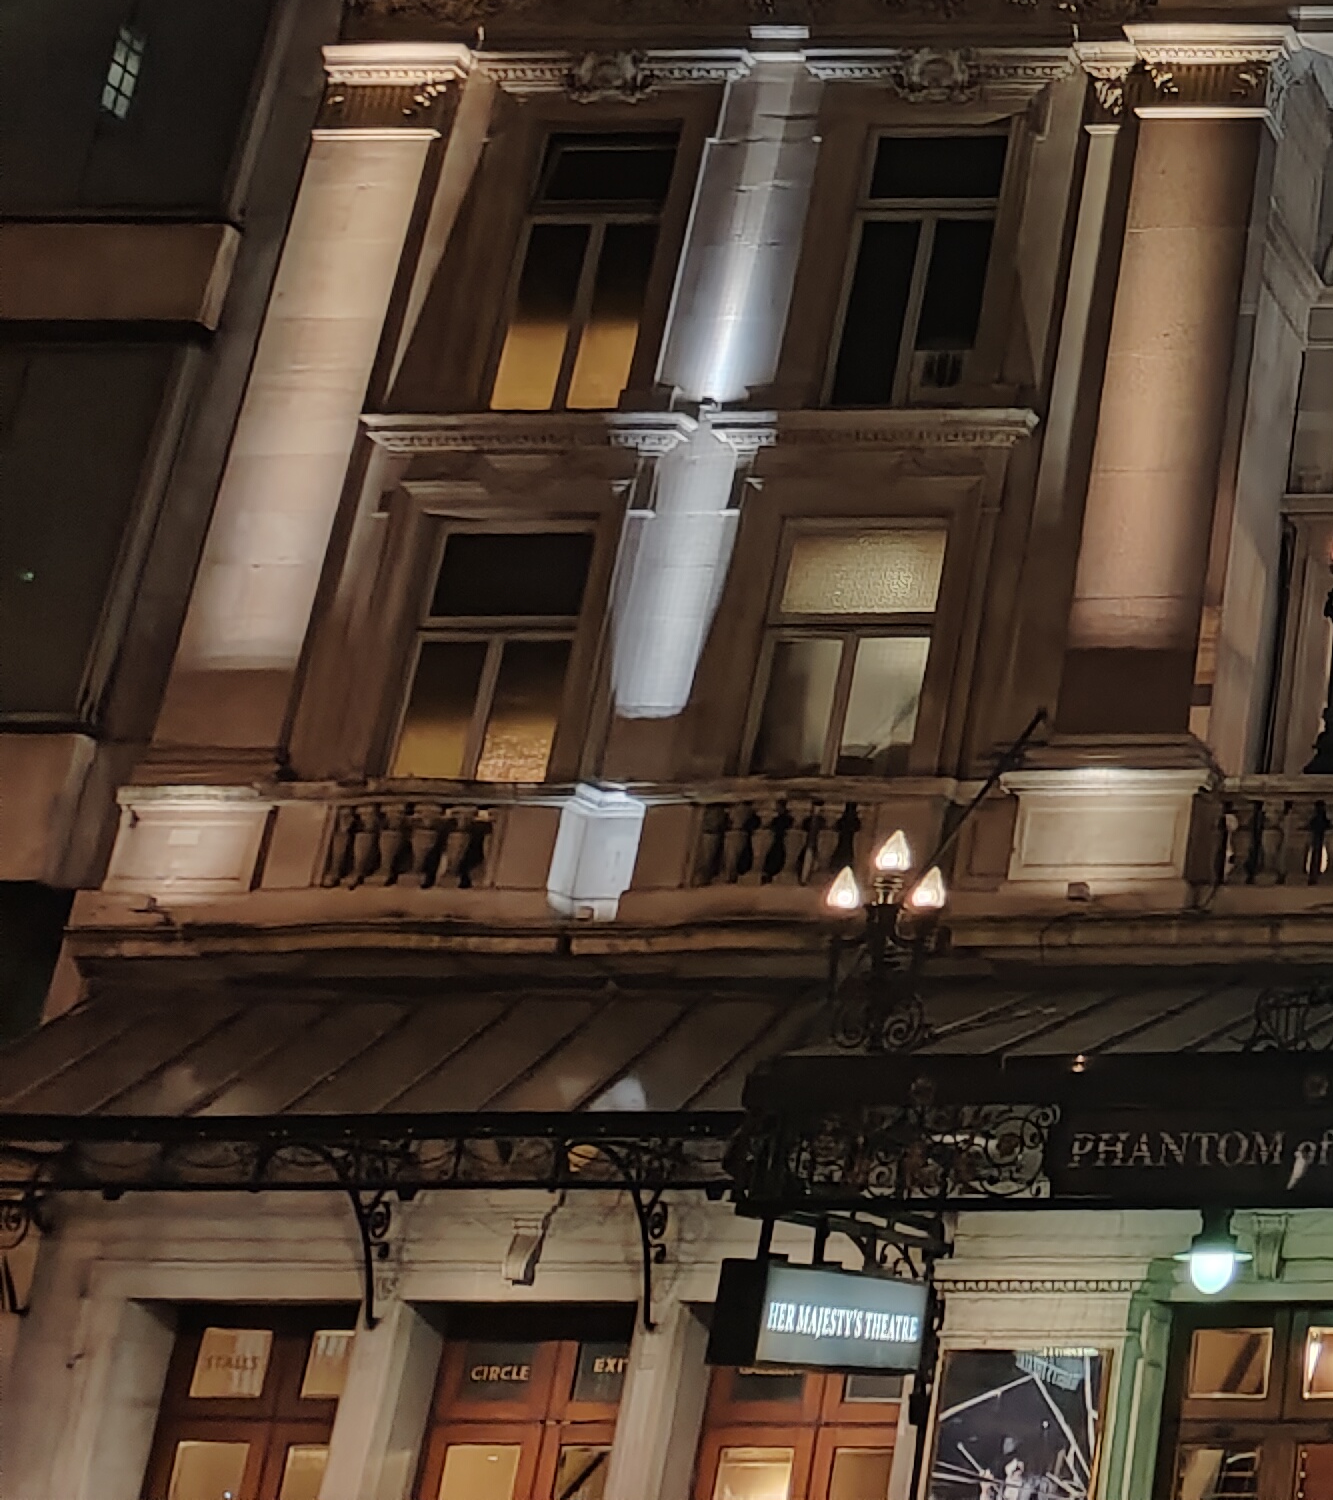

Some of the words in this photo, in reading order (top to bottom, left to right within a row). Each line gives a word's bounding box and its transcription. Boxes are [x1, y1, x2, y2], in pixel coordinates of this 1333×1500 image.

[1067, 1131, 1287, 1168] PHANTOM
[767, 1301, 796, 1332] HER
[796, 1305, 862, 1340] MAJESTY'S
[864, 1312, 919, 1342] THEATRE
[471, 1365, 531, 1381] CIRCLE
